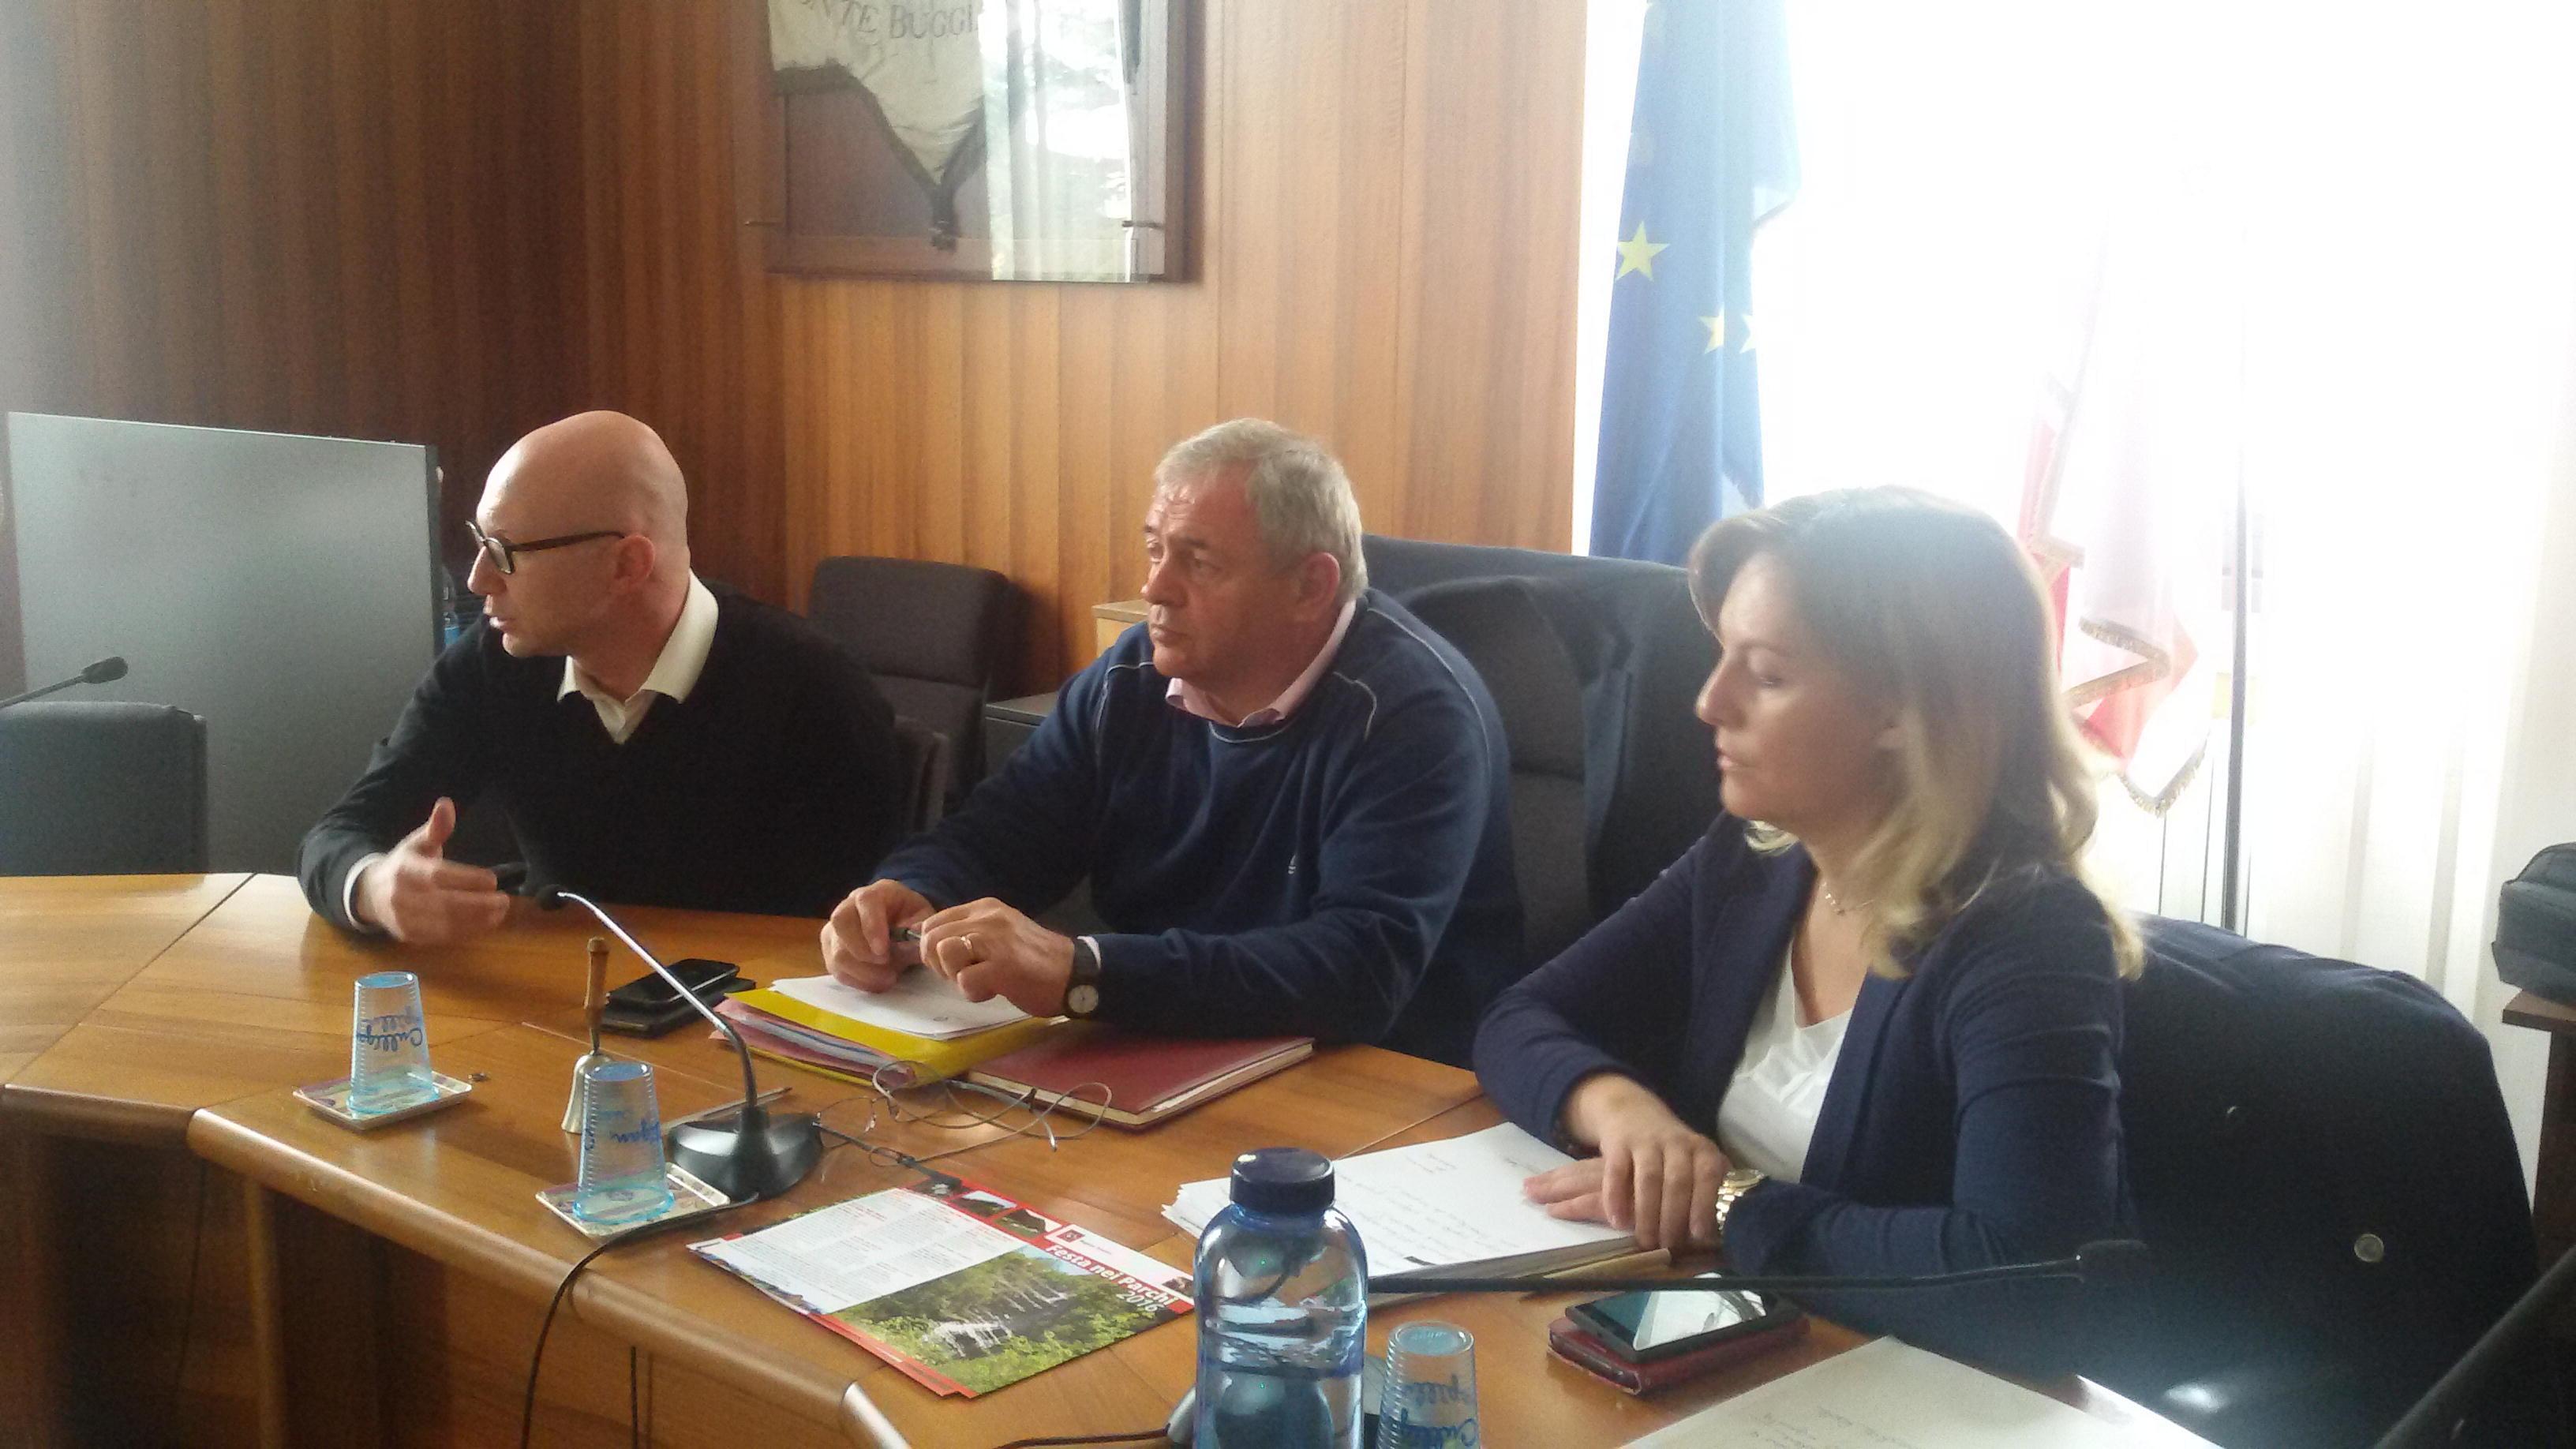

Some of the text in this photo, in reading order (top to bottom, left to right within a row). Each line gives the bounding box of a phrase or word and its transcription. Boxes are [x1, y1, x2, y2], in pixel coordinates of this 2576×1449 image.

[889, 4, 978, 39] BUGGI
[1046, 1244, 1088, 1267] Festa
[1091, 1261, 1125, 1280] nei
[1118, 1276, 1179, 1305] Parchi
[1116, 1290, 1166, 1312] 2016
